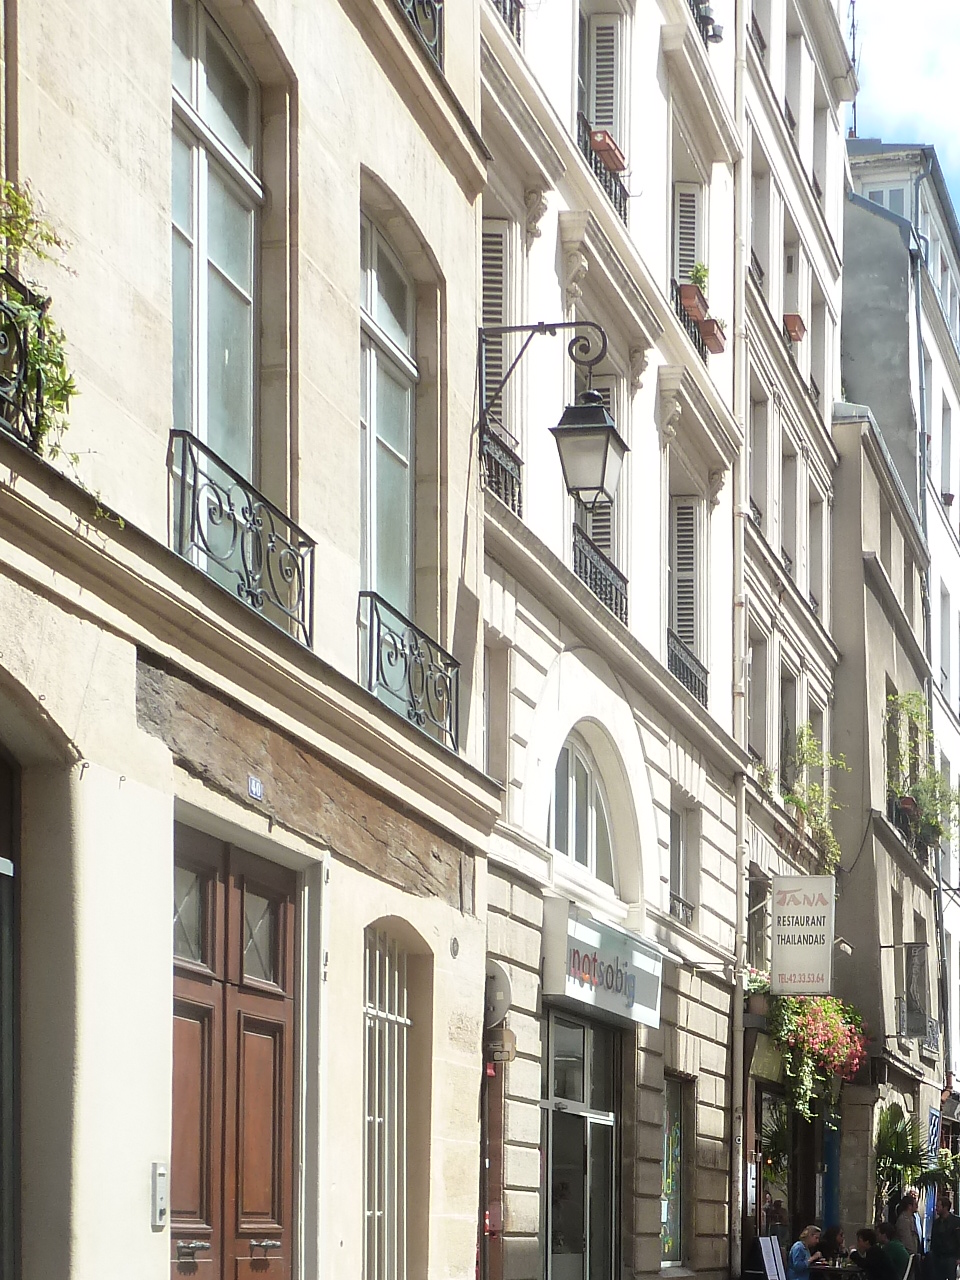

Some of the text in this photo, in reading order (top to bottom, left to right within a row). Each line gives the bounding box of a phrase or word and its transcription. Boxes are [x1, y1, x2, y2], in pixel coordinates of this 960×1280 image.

[776, 888, 829, 907] TANA
[776, 915, 827, 927] RESTAURANT
[776, 934, 826, 946] THAILANDAIS
